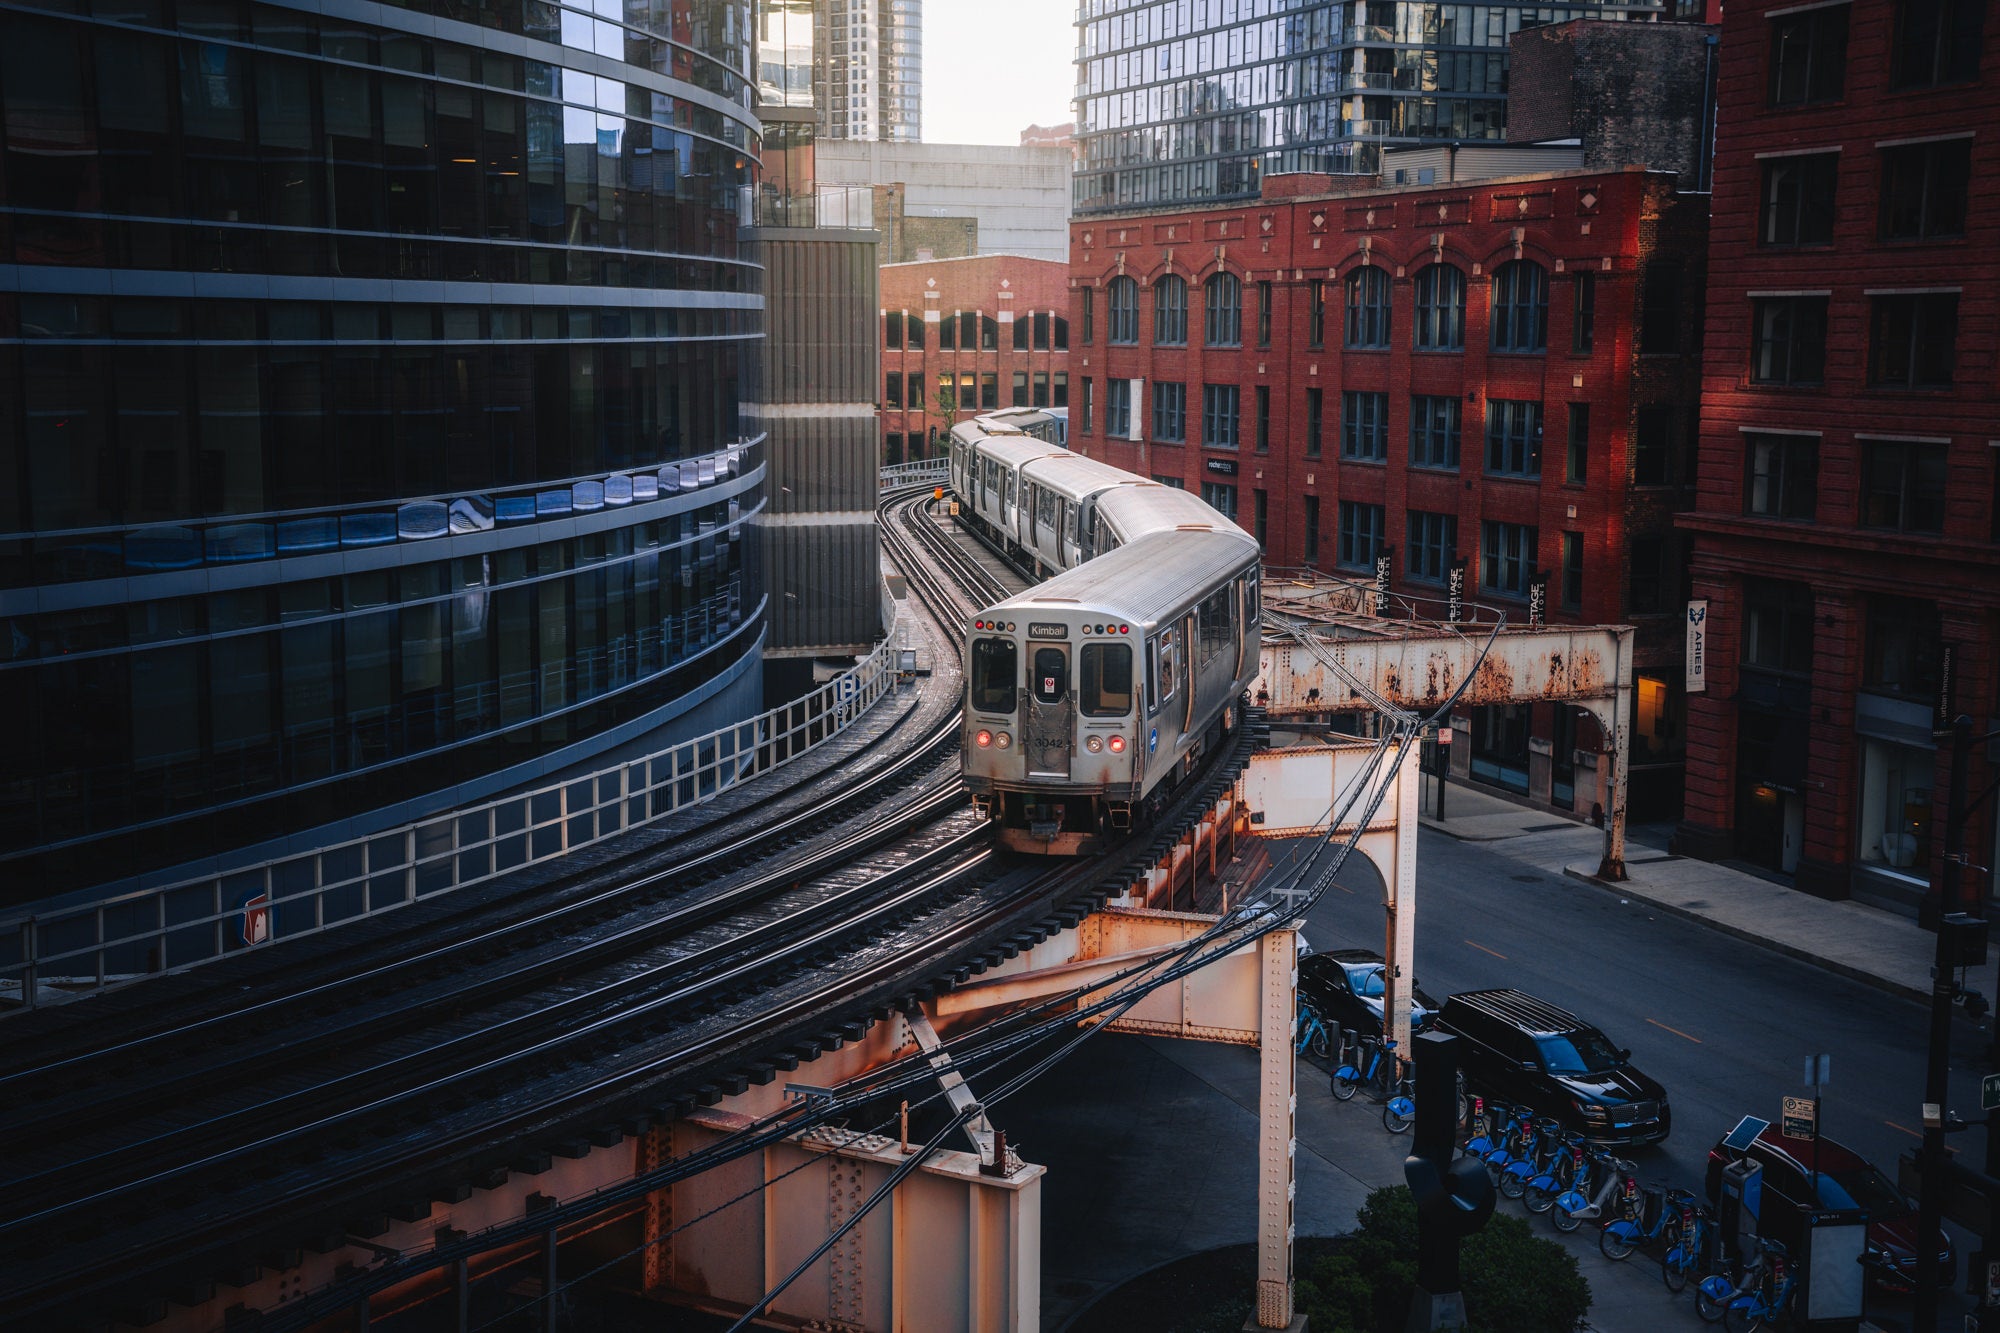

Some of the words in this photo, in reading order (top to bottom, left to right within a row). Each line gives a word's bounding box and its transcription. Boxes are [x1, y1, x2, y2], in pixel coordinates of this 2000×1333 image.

[1376, 556, 1386, 610] HERITAGE
[1031, 626, 1065, 636] Kimball
[1035, 738, 1063, 749] 3042
